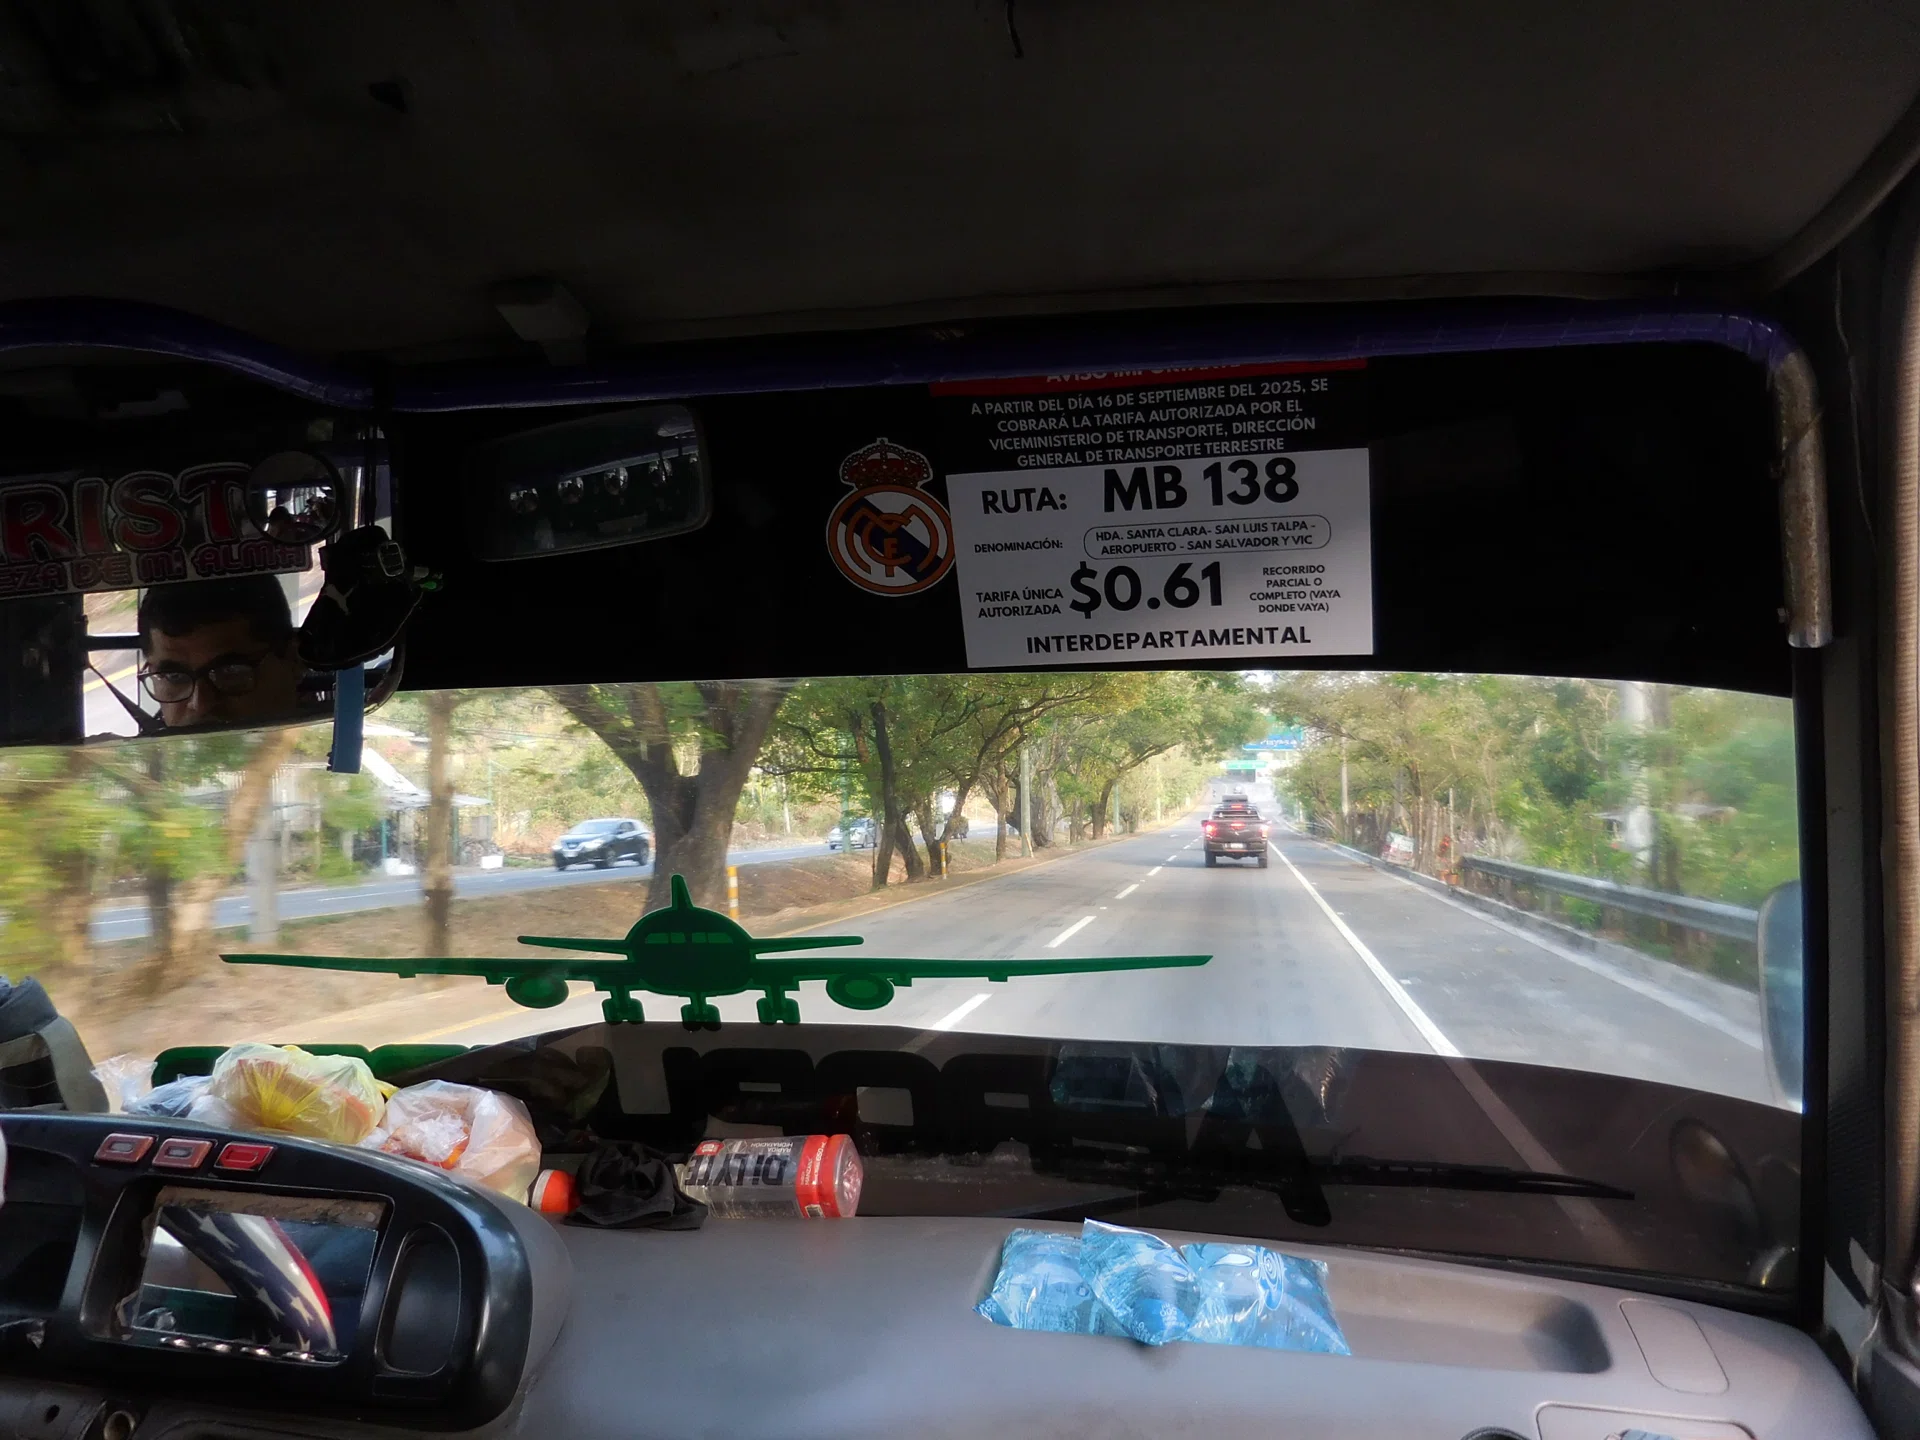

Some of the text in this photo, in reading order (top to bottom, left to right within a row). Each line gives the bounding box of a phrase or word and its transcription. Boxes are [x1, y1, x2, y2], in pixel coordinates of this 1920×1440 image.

[971, 378, 1329, 416] A PARTIR DEL DÍA 16 DE SEPTIEMBRE DEL 2025, SE
[997, 399, 1303, 433] COBRARÁ LA TARIFA AUTORIZADA POR EL
[989, 414, 1316, 451] VICEMINISTERIO DE TRANSPORTE, DIRECCIÓN
[1017, 438, 1284, 467] GENERAL DE TRANSPORTE TERRESTRE
[981, 457, 1299, 514] RUTA: MB 138
[0, 463, 251, 561] RIST
[1096, 531, 1124, 542] HDA.
[1126, 528, 1165, 540] SANTA
[1168, 526, 1212, 537] CLARA-
[1215, 524, 1240, 535] SAN
[1243, 522, 1268, 533] LUIS
[1271, 520, 1308, 532] TALPA
[974, 537, 1063, 553] DENOMINACIÓN:
[1101, 541, 1176, 555] AEROPUERTO
[1187, 540, 1213, 550] SAN
[1215, 536, 1279, 549] SALVADOR
[1281, 536, 1290, 546] Y
[1292, 535, 1313, 545] VIC
[71, 553, 132, 587] DE
[194, 539, 307, 576] ALMA
[1262, 565, 1325, 576] RECORRIDO
[976, 586, 1064, 603] TARIFA ÚNICA
[1069, 561, 1222, 619] $0.61
[1266, 577, 1323, 588] PARCIAL O
[1249, 589, 1341, 601] COMPLETO (VAYA
[978, 604, 1061, 618] AUTORIZADA
[1258, 602, 1329, 613] DONDE VAYA)
[1027, 626, 1311, 653] INTERDEPARTAMENTAL
